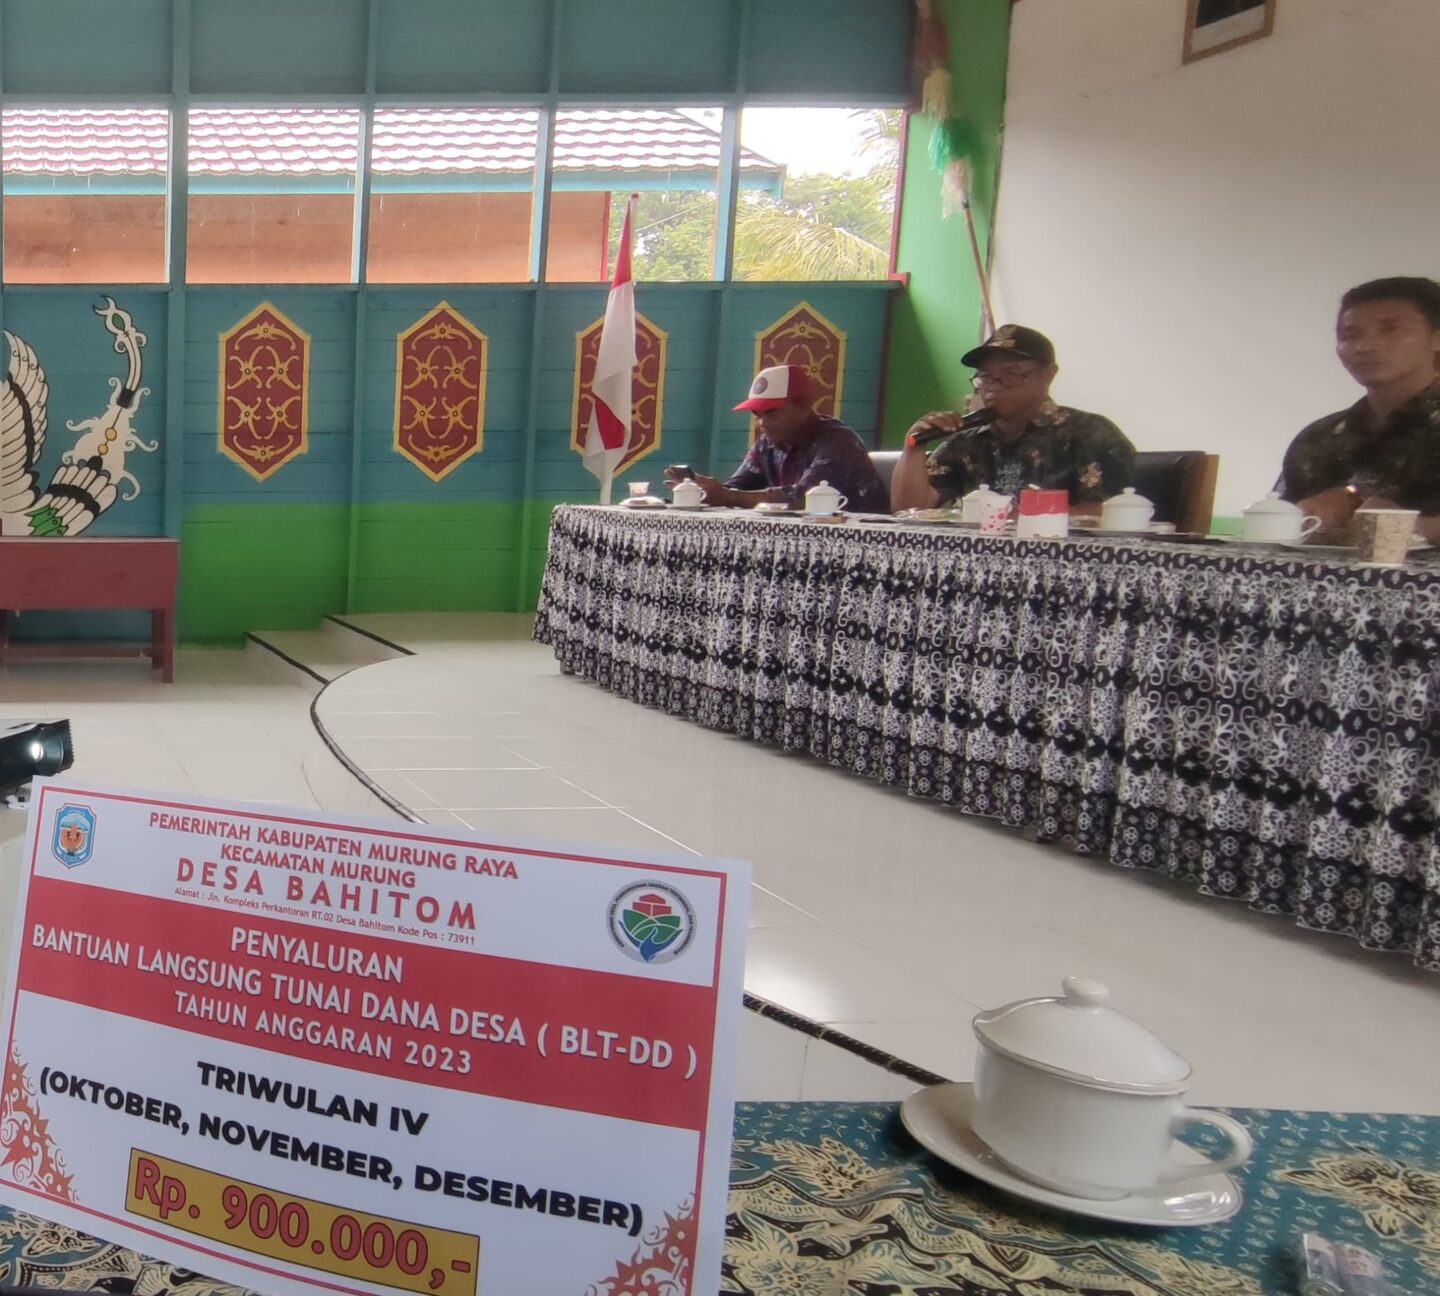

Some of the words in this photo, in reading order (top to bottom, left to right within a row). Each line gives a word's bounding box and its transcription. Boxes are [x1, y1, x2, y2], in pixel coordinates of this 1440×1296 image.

[149, 811, 251, 842] PEMERINTAH
[256, 826, 362, 858] KABUPATEN
[367, 842, 458, 871] MURUNG
[464, 855, 519, 880] RAYA
[220, 843, 325, 875] KECAMATAN
[330, 858, 416, 888] MURUNG
[174, 887, 200, 899] Alamat
[207, 892, 221, 903] Jln.
[223, 895, 259, 910] Kompleks
[261, 901, 310, 918] Perkantoran
[311, 910, 333, 922] RT.02
[336, 913, 356, 926] Desa
[358, 918, 395, 933] Bahitom
[397, 925, 420, 937] Kode
[422, 929, 438, 940] Pos
[447, 933, 475, 945] 73911
[176, 857, 264, 895] DESA
[286, 875, 477, 930] BAHITOM
[230, 926, 403, 984] PENYALURAN
[32, 924, 130, 967] BANTUAN
[137, 945, 263, 996] LANGSUNG
[270, 973, 351, 1015] TUNAI
[361, 991, 440, 1032] DANA
[449, 1007, 527, 1047] DESA
[560, 1025, 673, 1069] BLT-DD
[174, 990, 248, 1029] TAHUN
[255, 1010, 392, 1061] ANGGARAN
[404, 1041, 472, 1074] 2023
[197, 1061, 378, 1128] TRIWULAN
[389, 1107, 430, 1136] IV
[40, 1066, 191, 1136] (OKTOBER,
[199, 1112, 404, 1191] NOVEMBER,
[414, 1164, 644, 1237] DESEMBER)
[133, 1157, 201, 1219] Rp.
[222, 1184, 472, 1290] 900.000,-
